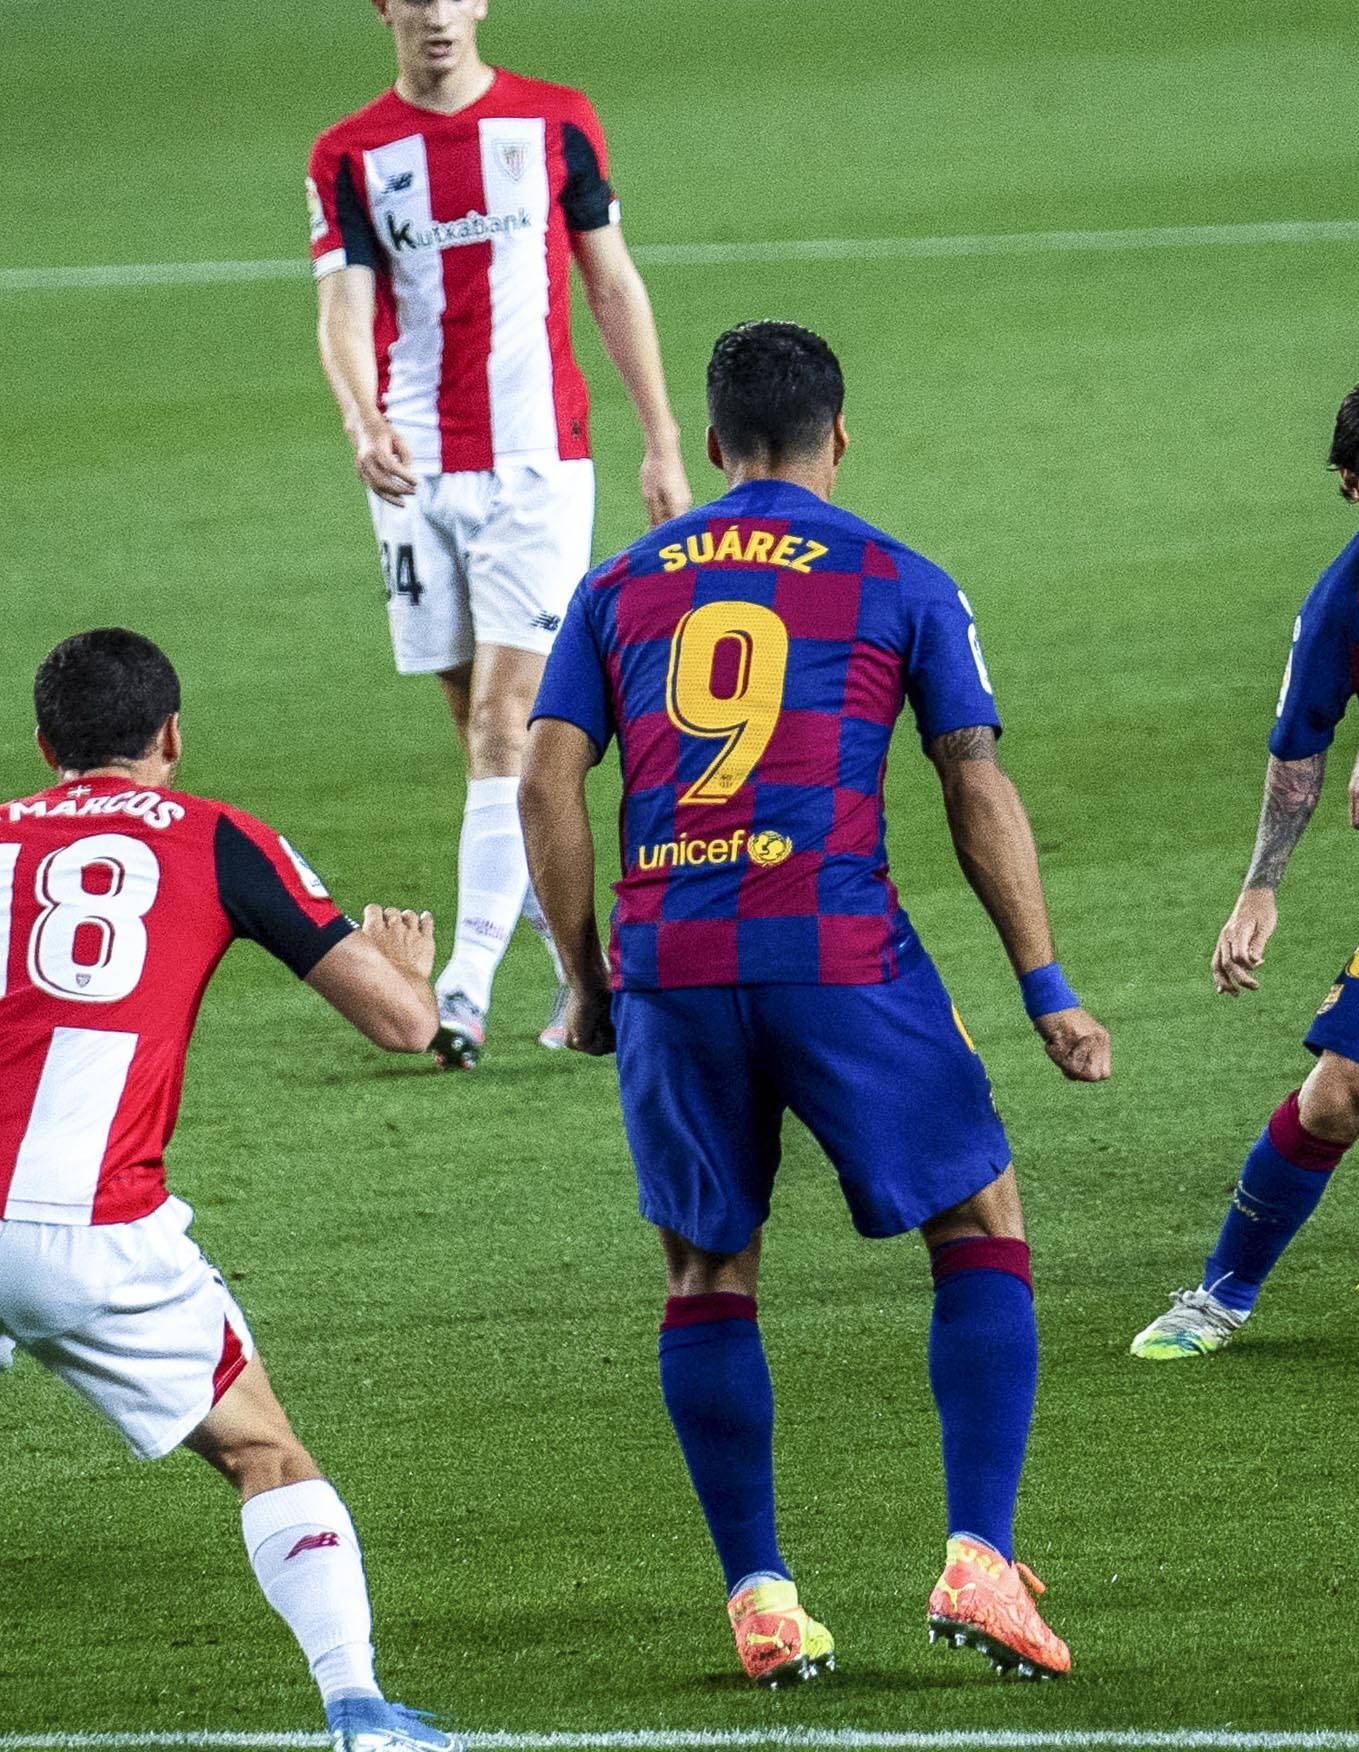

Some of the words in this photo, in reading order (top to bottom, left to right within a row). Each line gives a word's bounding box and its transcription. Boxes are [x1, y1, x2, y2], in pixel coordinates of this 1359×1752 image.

[658, 525, 829, 575] SUÁREZ
[666, 600, 789, 805] 9
[8, 791, 185, 829] MARCOS
[638, 829, 745, 872] unicef
